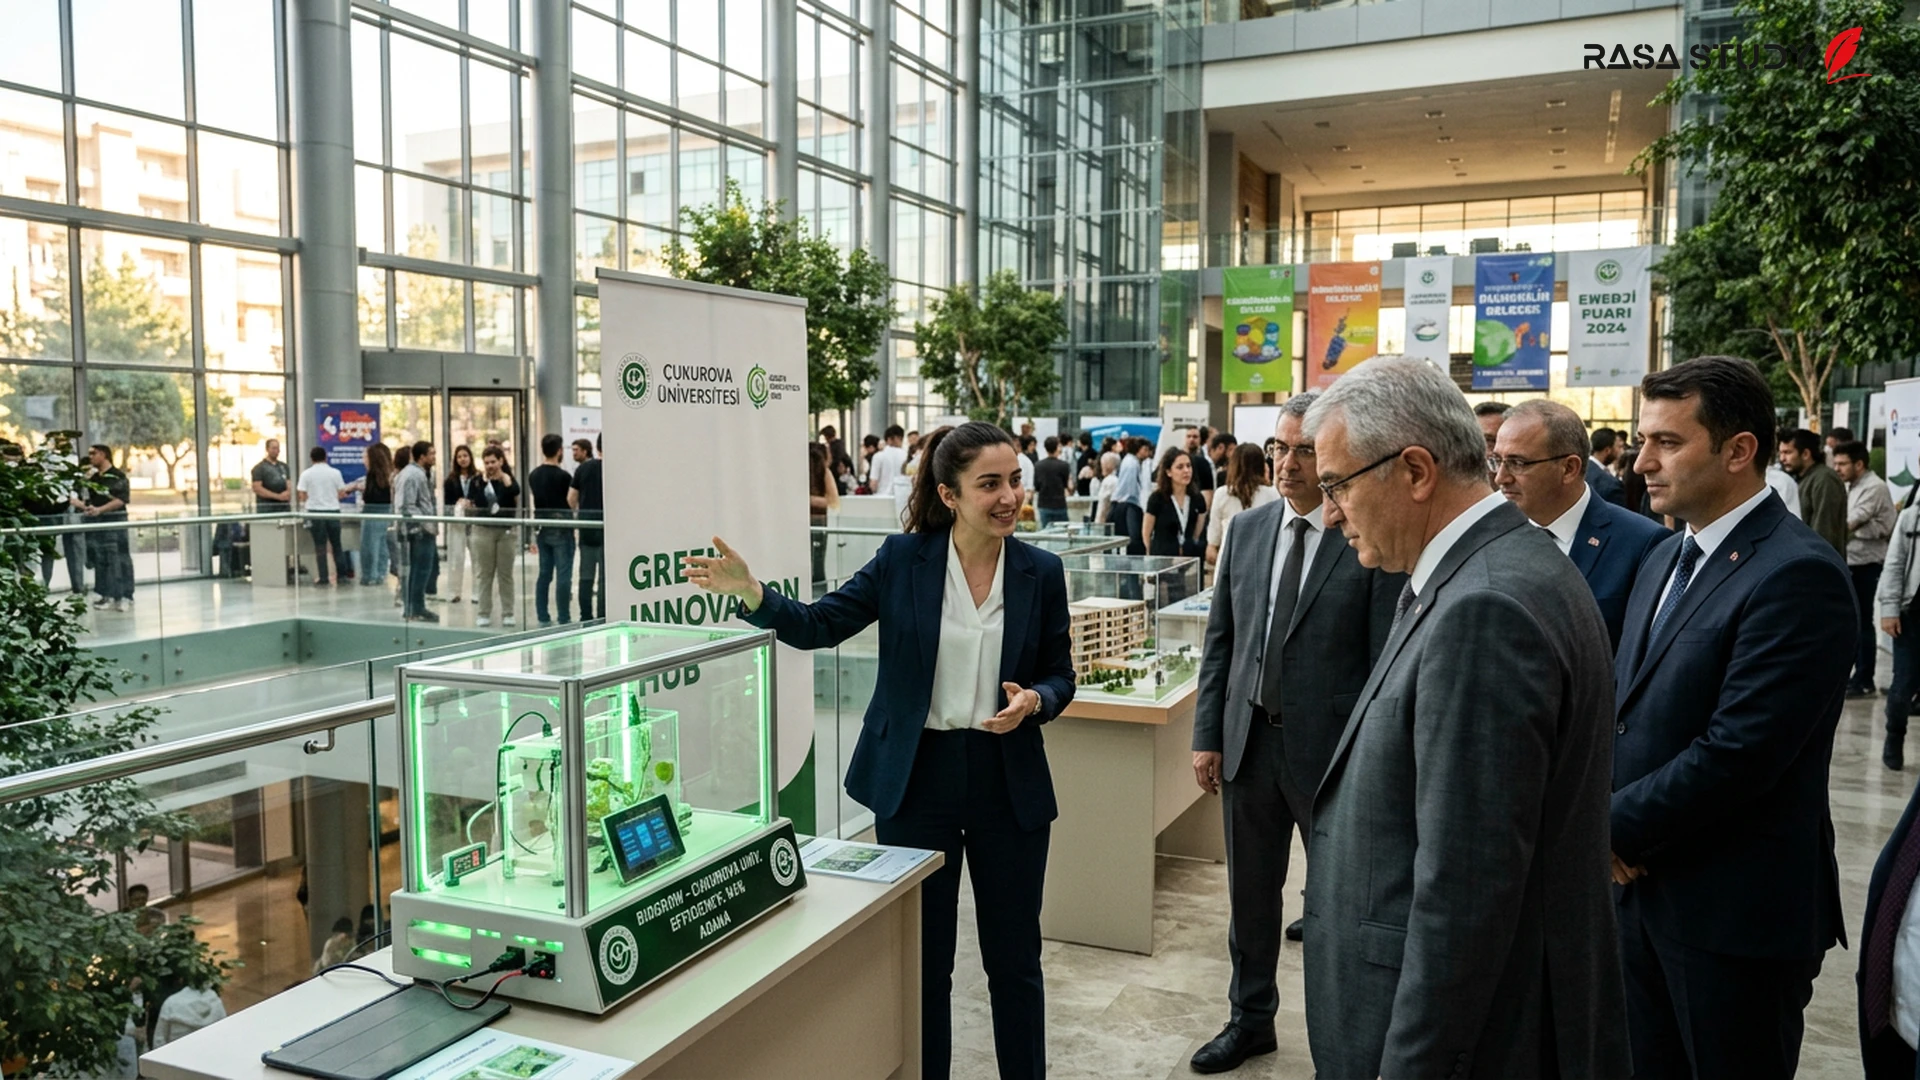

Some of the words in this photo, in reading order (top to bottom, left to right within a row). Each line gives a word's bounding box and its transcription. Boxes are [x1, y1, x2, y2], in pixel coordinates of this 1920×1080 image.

[1582, 307, 1631, 320] PUARI
[1586, 322, 1627, 334] 2024
[662, 363, 733, 385] ÇUKUROVA
